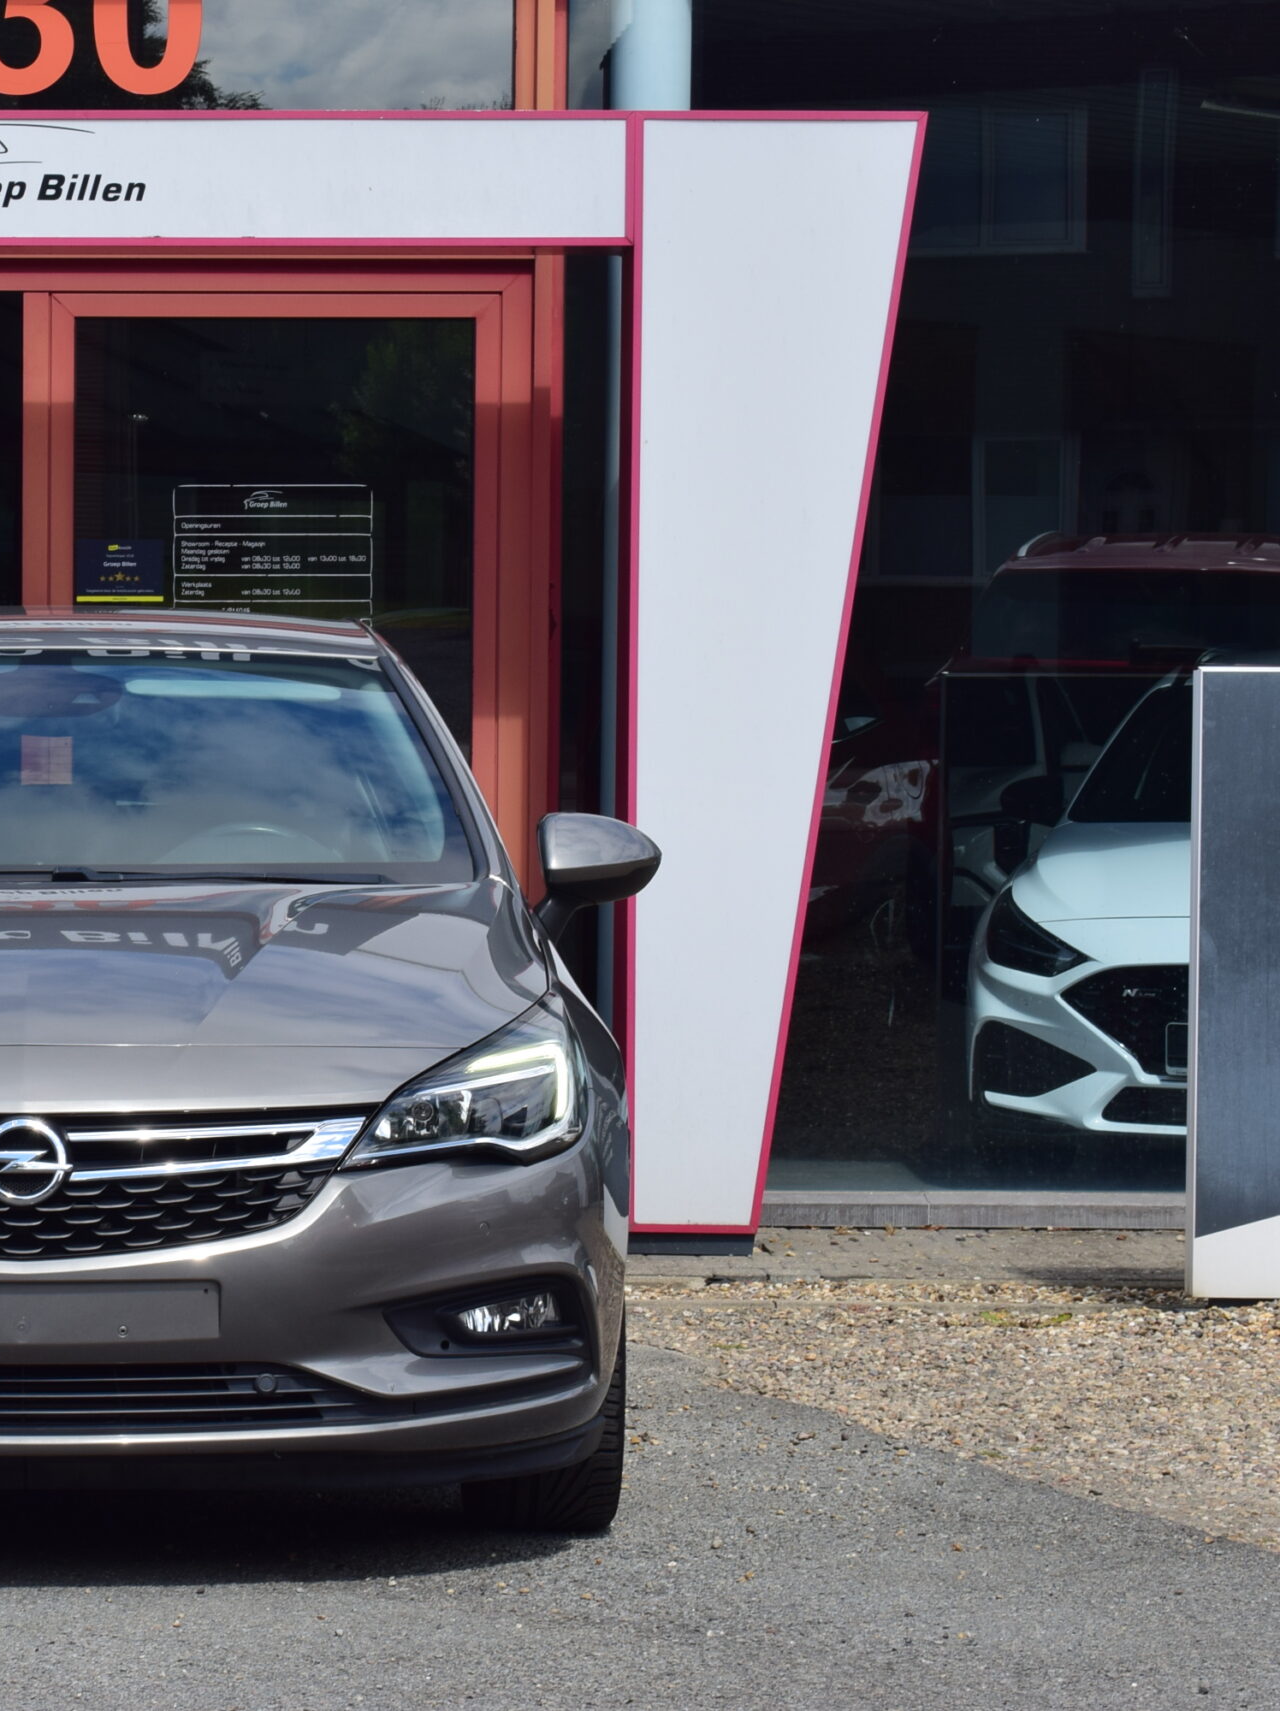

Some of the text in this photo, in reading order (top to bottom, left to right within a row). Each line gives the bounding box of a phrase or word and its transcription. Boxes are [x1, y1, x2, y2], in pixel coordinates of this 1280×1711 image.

[37, 173, 146, 202] Billen
[249, 500, 288, 509] Groep Billen
[181, 521, 221, 531] Openingsuren
[181, 540, 210, 548] Showroom
[181, 548, 206, 557] Maandag
